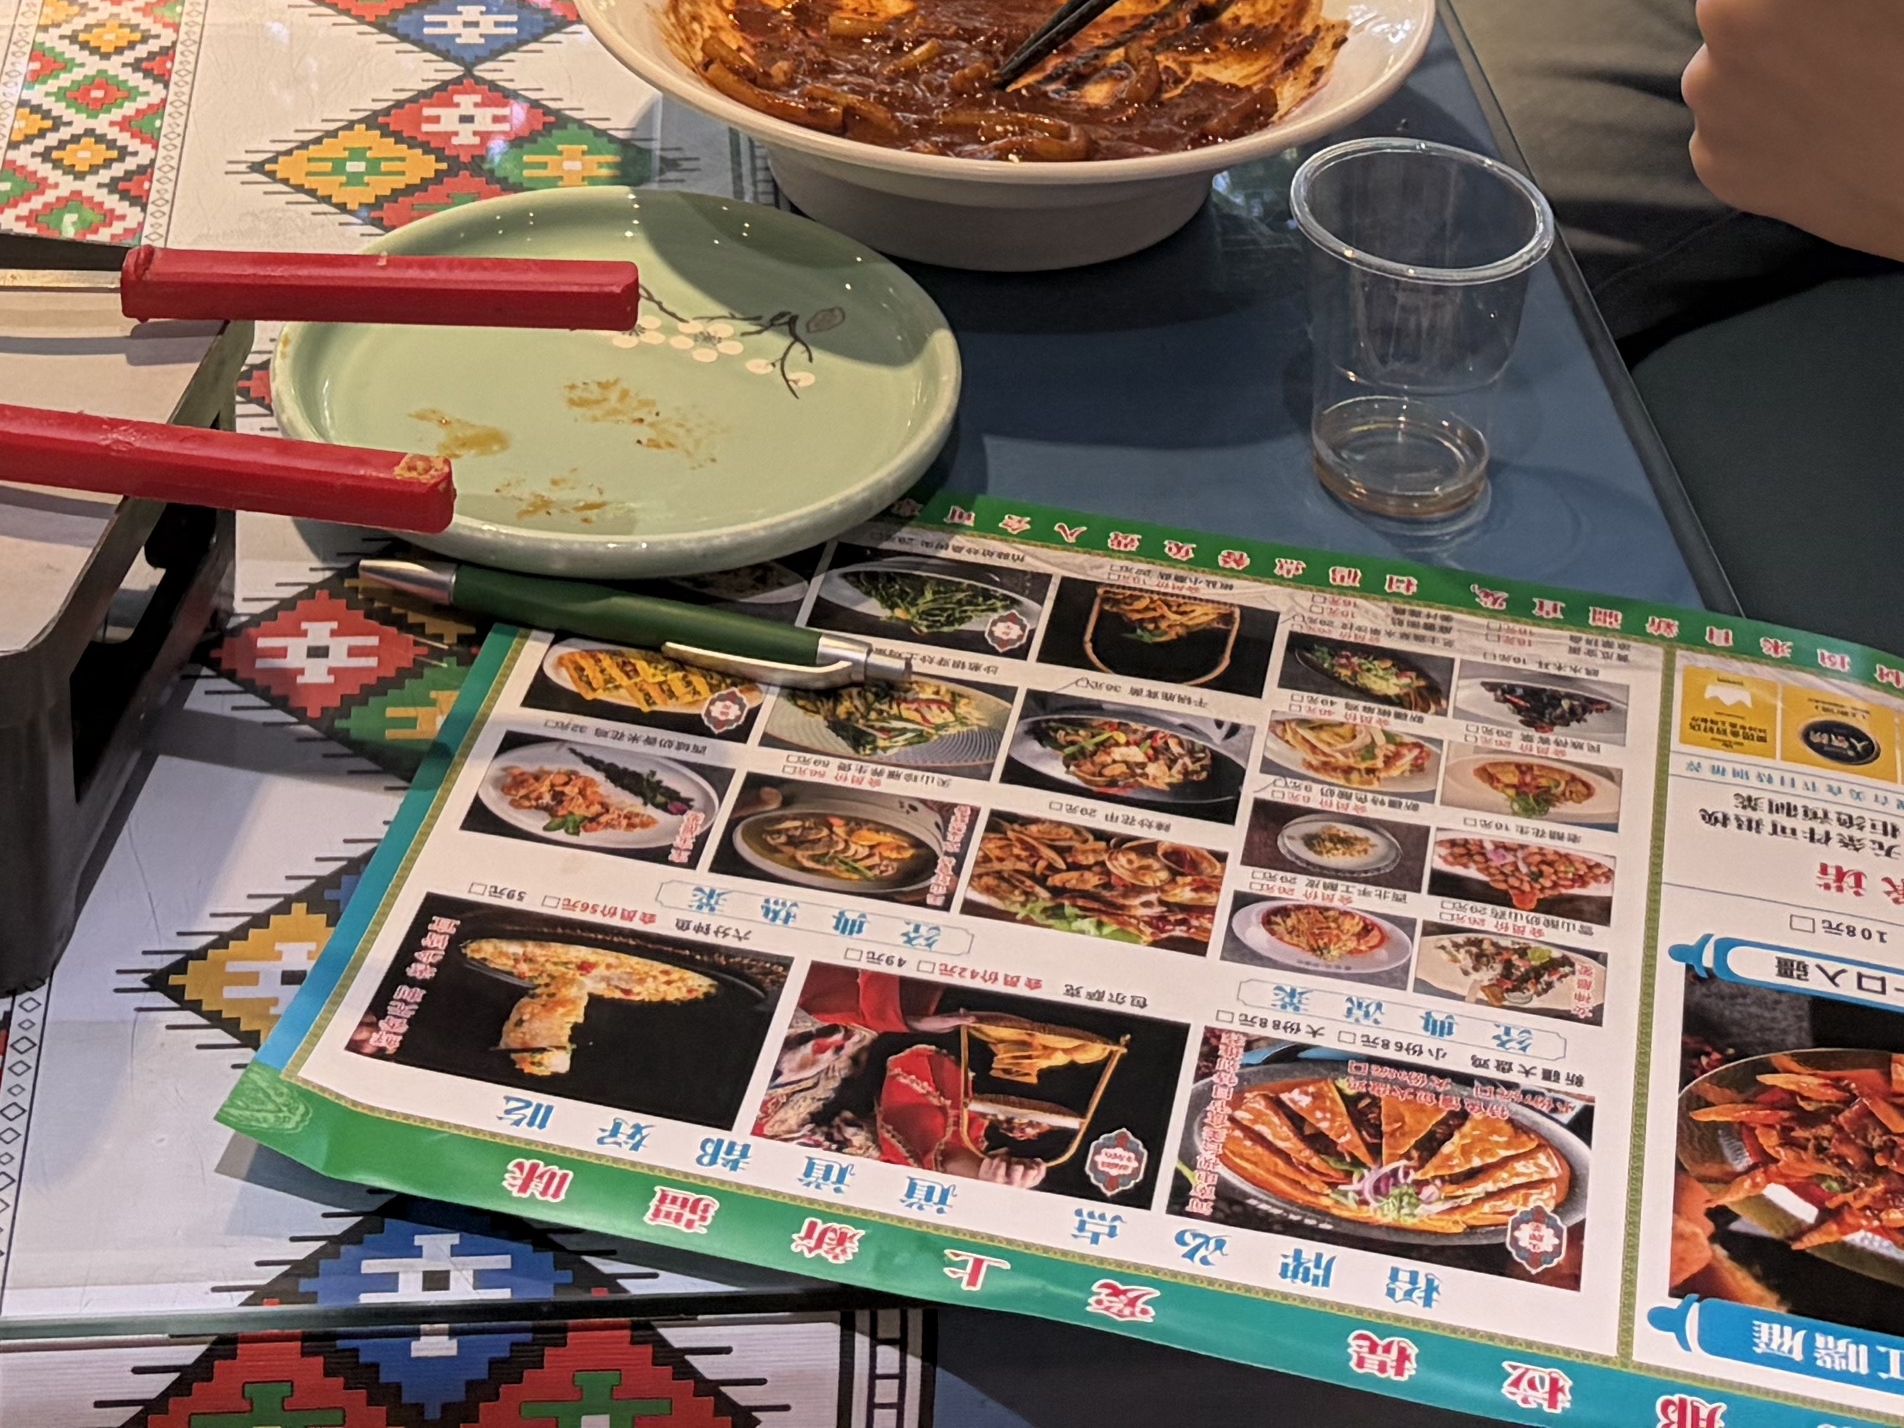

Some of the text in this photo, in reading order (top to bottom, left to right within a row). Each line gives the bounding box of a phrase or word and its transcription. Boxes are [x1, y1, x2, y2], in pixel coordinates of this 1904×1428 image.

[1698, 808, 1901, 860] 无条件可退换
[488, 884, 752, 942] 六分钟鱼 会员价56元 59元
[689, 886, 941, 951] 经典热菜
[1495, 921, 1545, 939] 会员价
[1821, 920, 1888, 943] 108元
[865, 950, 1148, 1010] 包尔萨克 会员价42元 49元
[1238, 1012, 1585, 1088] 新疆大盘鸡 小份68元 大份88元
[1271, 986, 1535, 1053] 经典凉菜
[497, 1095, 1441, 1310] 招牌必点 道道都好吃
[503, 1159, 1160, 1323] 爱上新疆味
